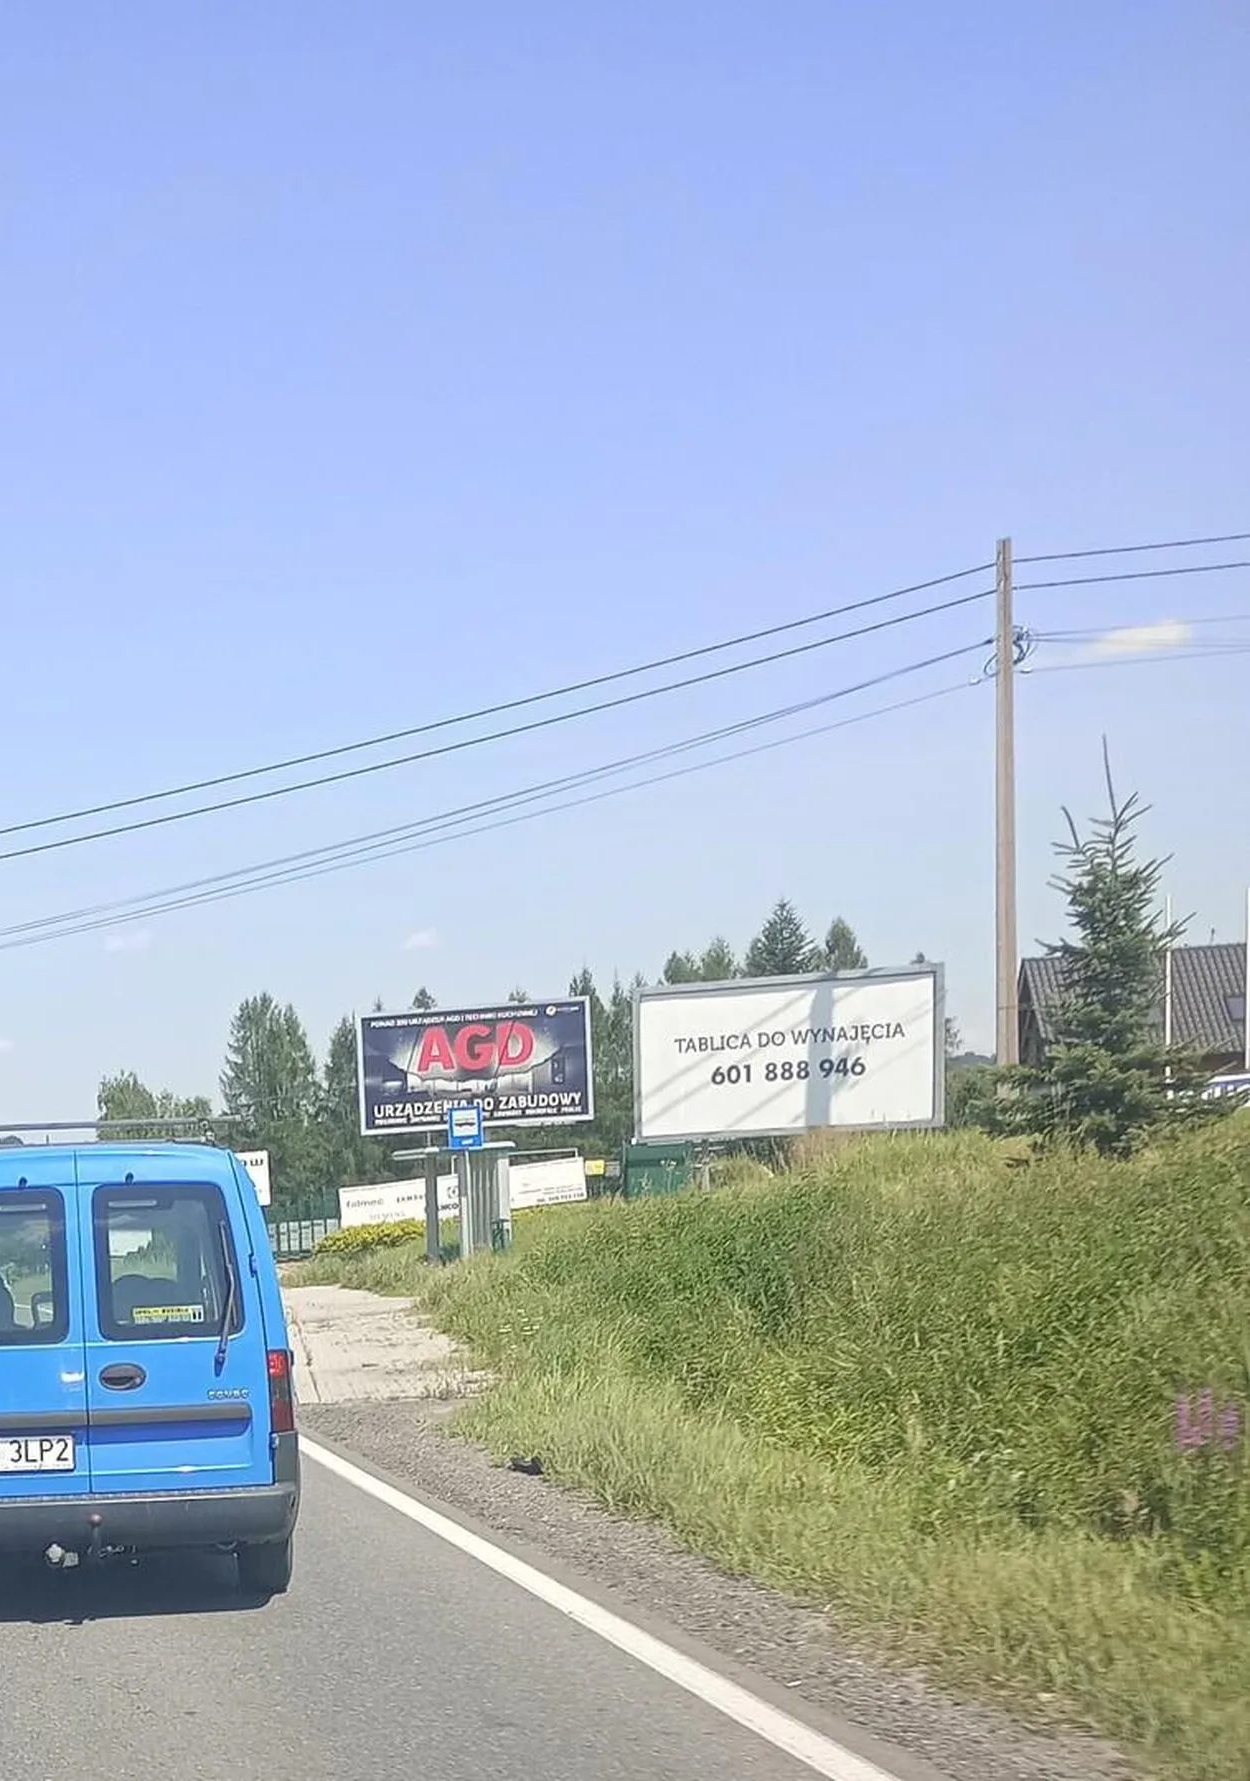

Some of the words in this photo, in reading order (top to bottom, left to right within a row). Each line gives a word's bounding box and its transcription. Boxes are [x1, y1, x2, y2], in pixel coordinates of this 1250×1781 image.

[416, 1020, 536, 1073] AGD
[674, 1033, 752, 1054] TABLICA
[757, 1030, 786, 1049] DO
[791, 1022, 906, 1045] WYNAJĘCIA
[710, 1064, 752, 1085] 601
[764, 1061, 810, 1083] 888
[818, 1056, 867, 1079] 946
[472, 1097, 494, 1111] DO
[498, 1091, 582, 1110] ZABUDOWY
[8, 1438, 69, 1463] 3LP2
